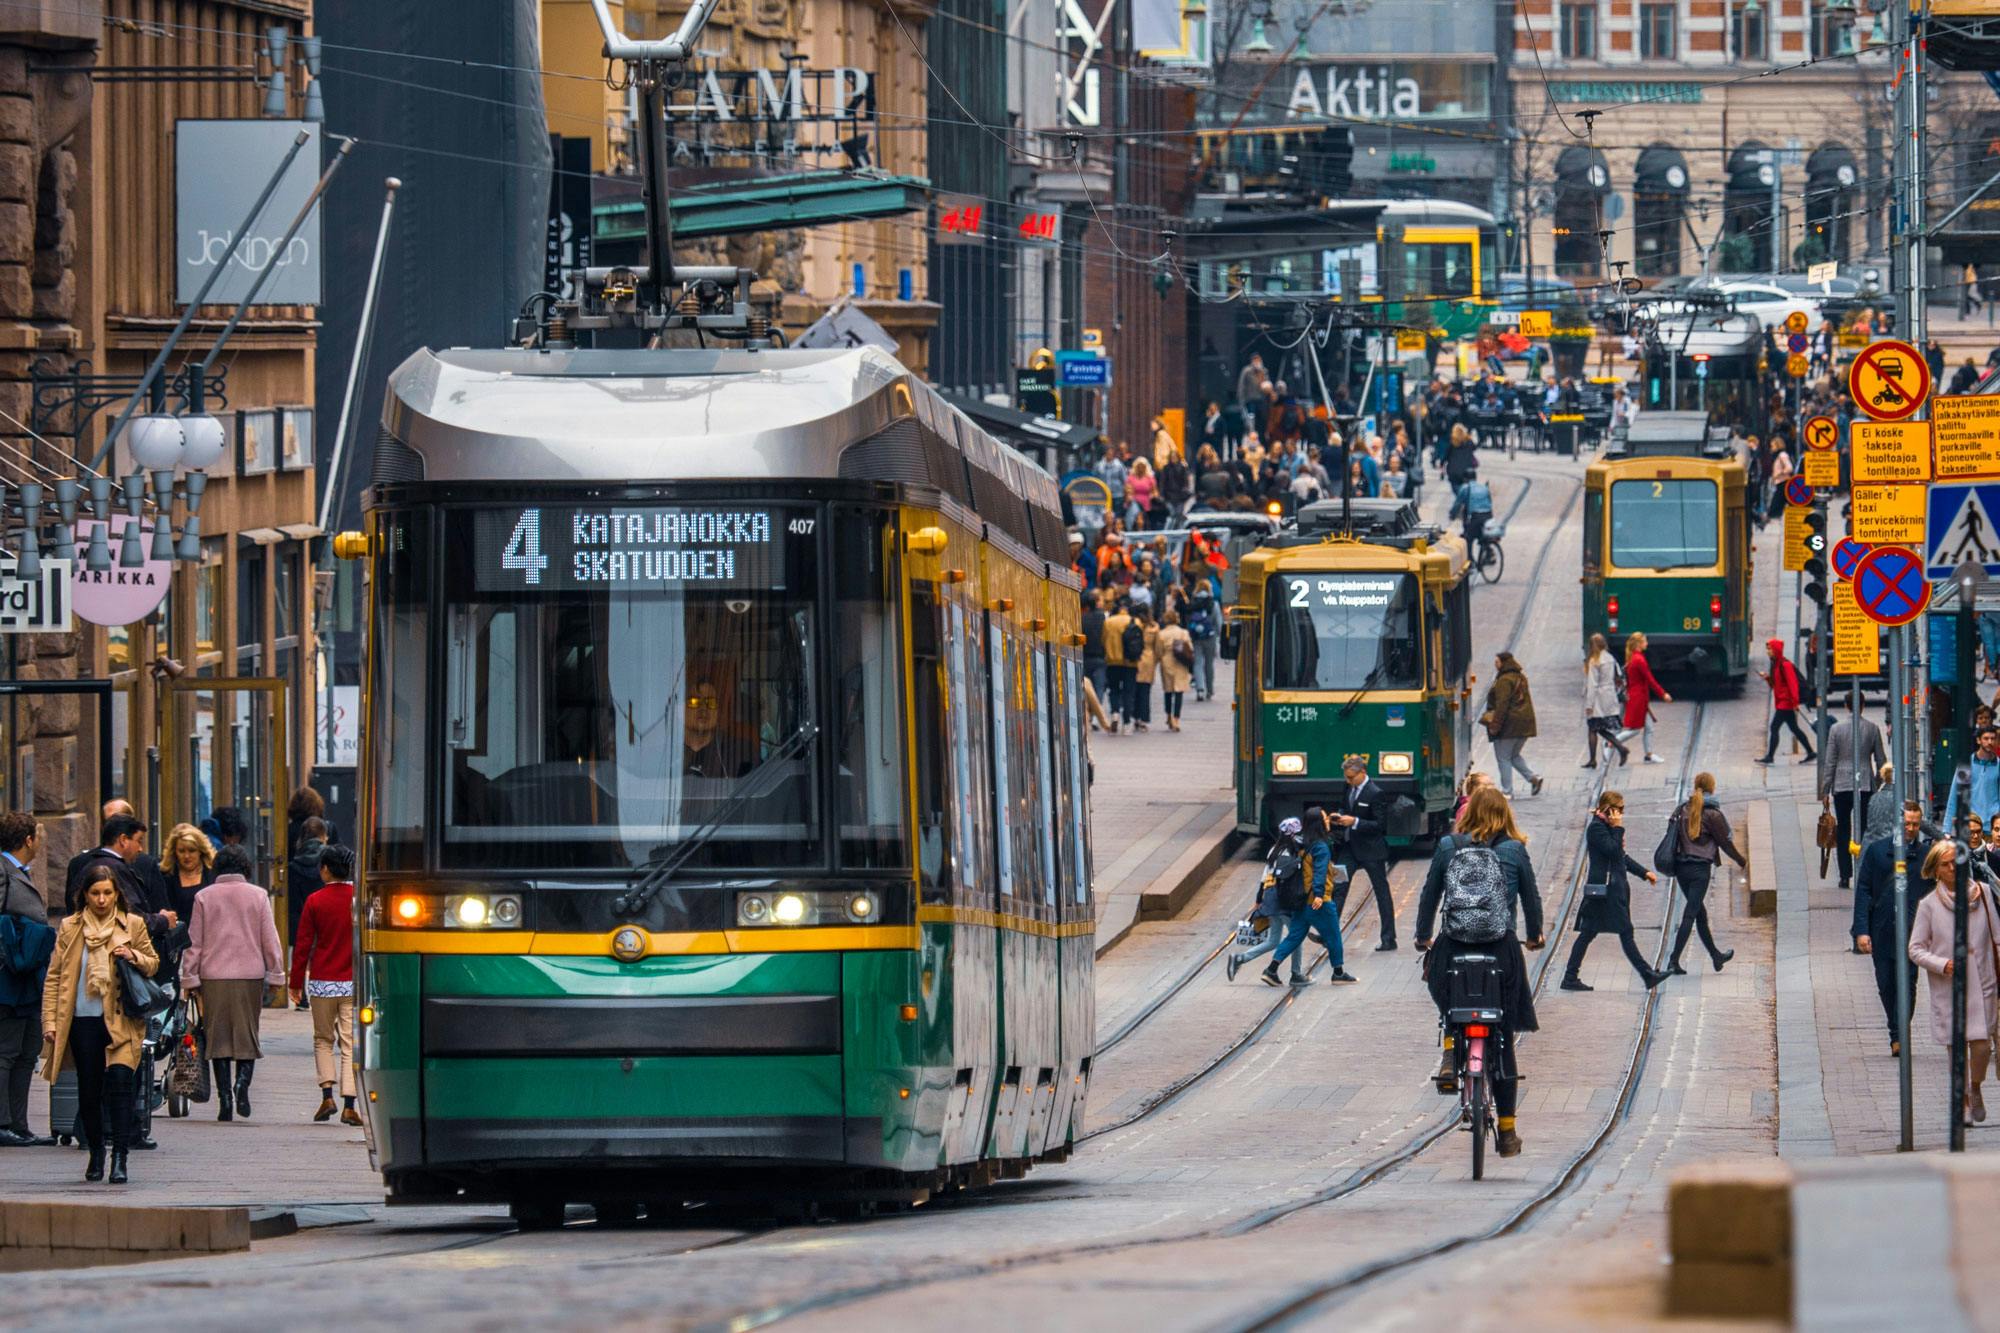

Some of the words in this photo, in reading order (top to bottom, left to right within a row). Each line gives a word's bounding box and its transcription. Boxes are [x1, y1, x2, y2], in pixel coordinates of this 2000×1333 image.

[1286, 66, 1420, 118] Aktia
[1862, 429, 1871, 438] Ei
[1875, 428, 1904, 438] koske
[1652, 481, 1663, 498] 2
[1855, 489, 1882, 500] Gäller
[788, 519, 815, 535] 407
[502, 509, 548, 584] 4
[573, 513, 770, 544] KATAJANOKKA
[573, 550, 735, 581] SKATUDDEN
[1290, 580, 1310, 607] 2
[1322, 595, 1338, 605] via
[1683, 617, 1701, 630] 89
